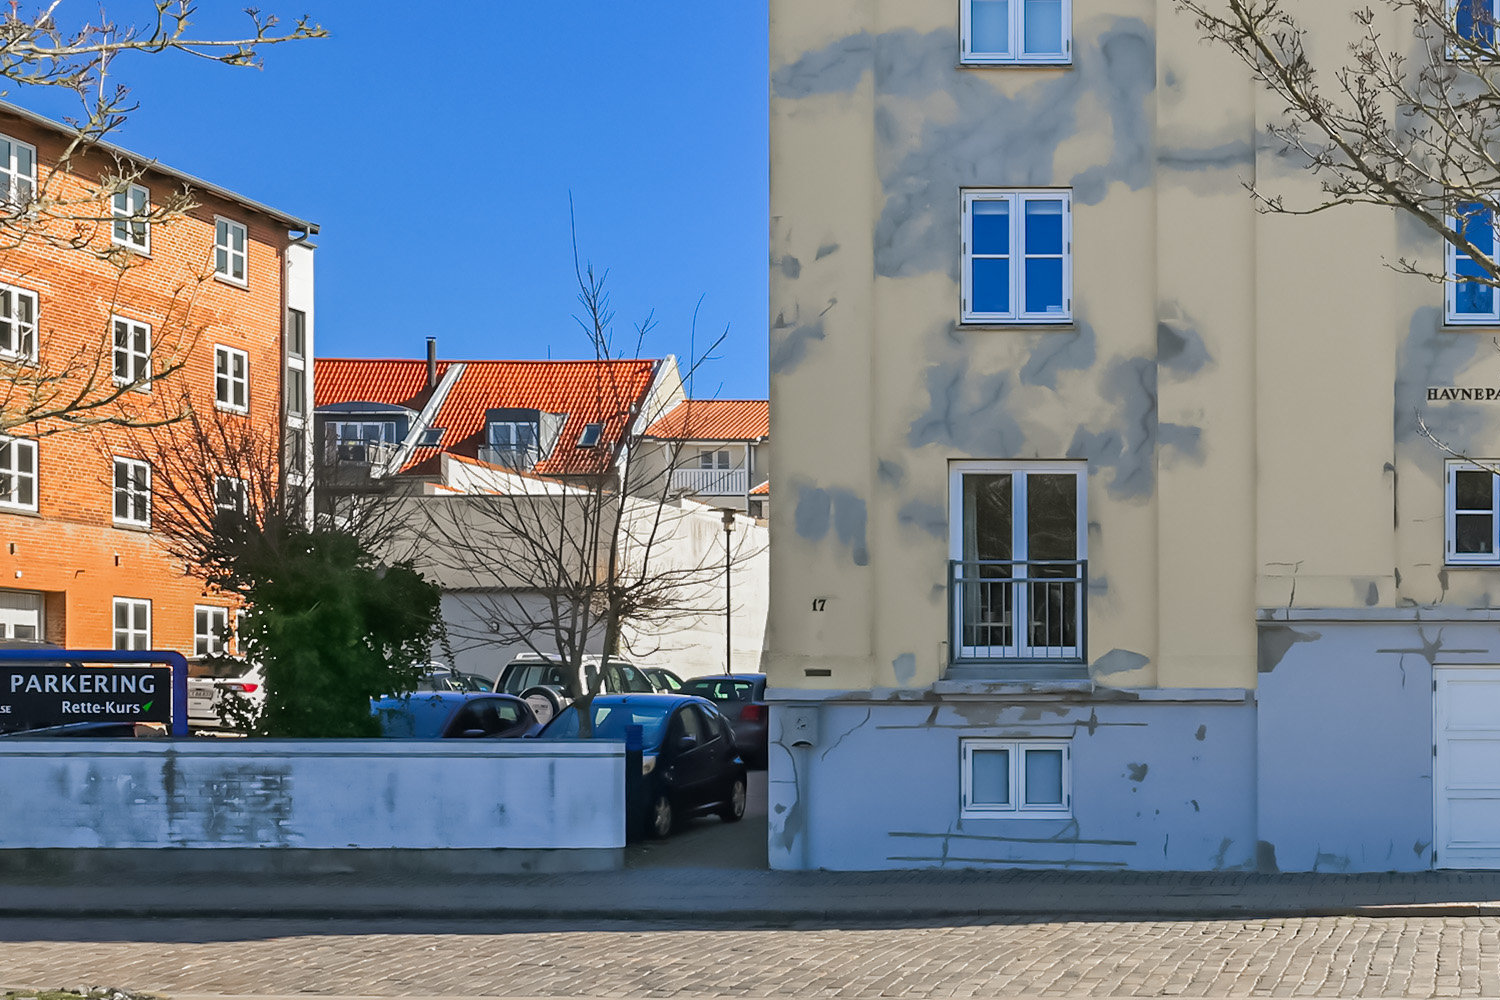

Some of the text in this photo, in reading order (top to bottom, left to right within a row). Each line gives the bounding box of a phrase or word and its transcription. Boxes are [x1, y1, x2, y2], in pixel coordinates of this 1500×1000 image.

[812, 599, 827, 612] 17
[10, 674, 155, 694] PARKERING
[61, 700, 141, 714] Rette-Kurs
